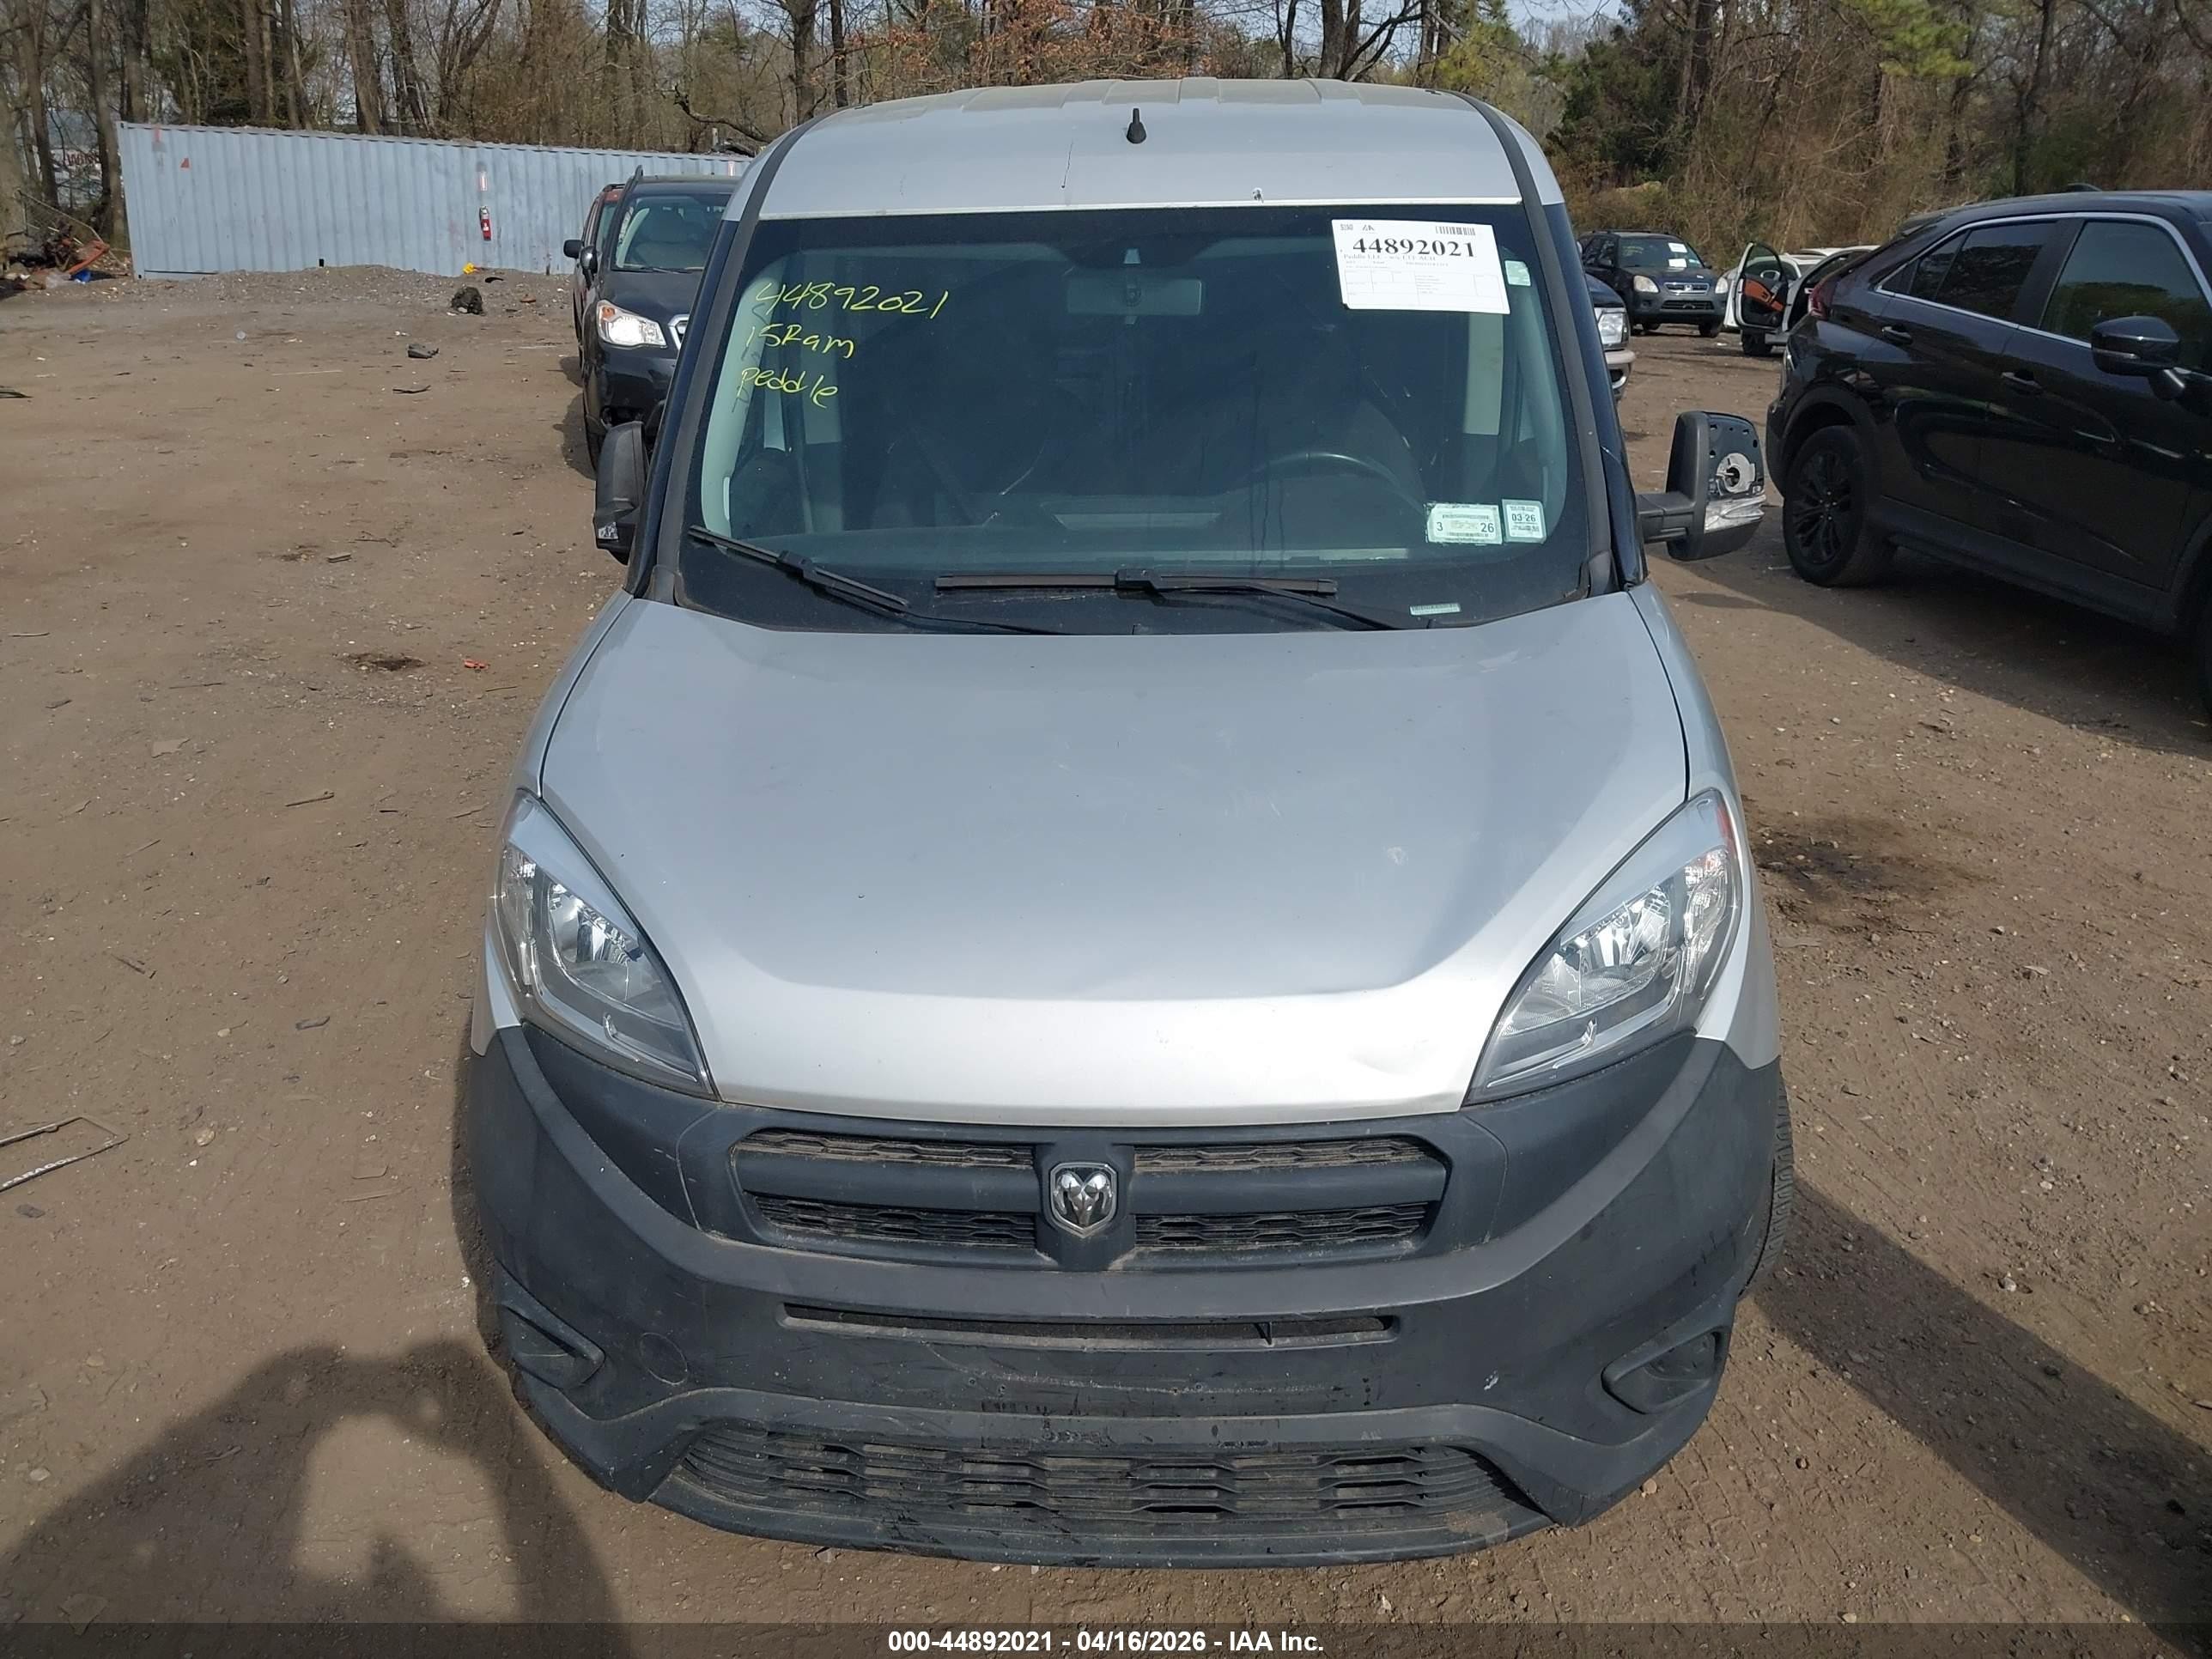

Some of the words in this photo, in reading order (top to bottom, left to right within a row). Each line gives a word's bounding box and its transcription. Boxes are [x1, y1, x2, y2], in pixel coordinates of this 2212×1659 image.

[1352, 237, 1475, 258] 44892021
[756, 282, 949, 319] 44892021
[1436, 521, 1443, 532] 3
[1480, 522, 1495, 533] 26
